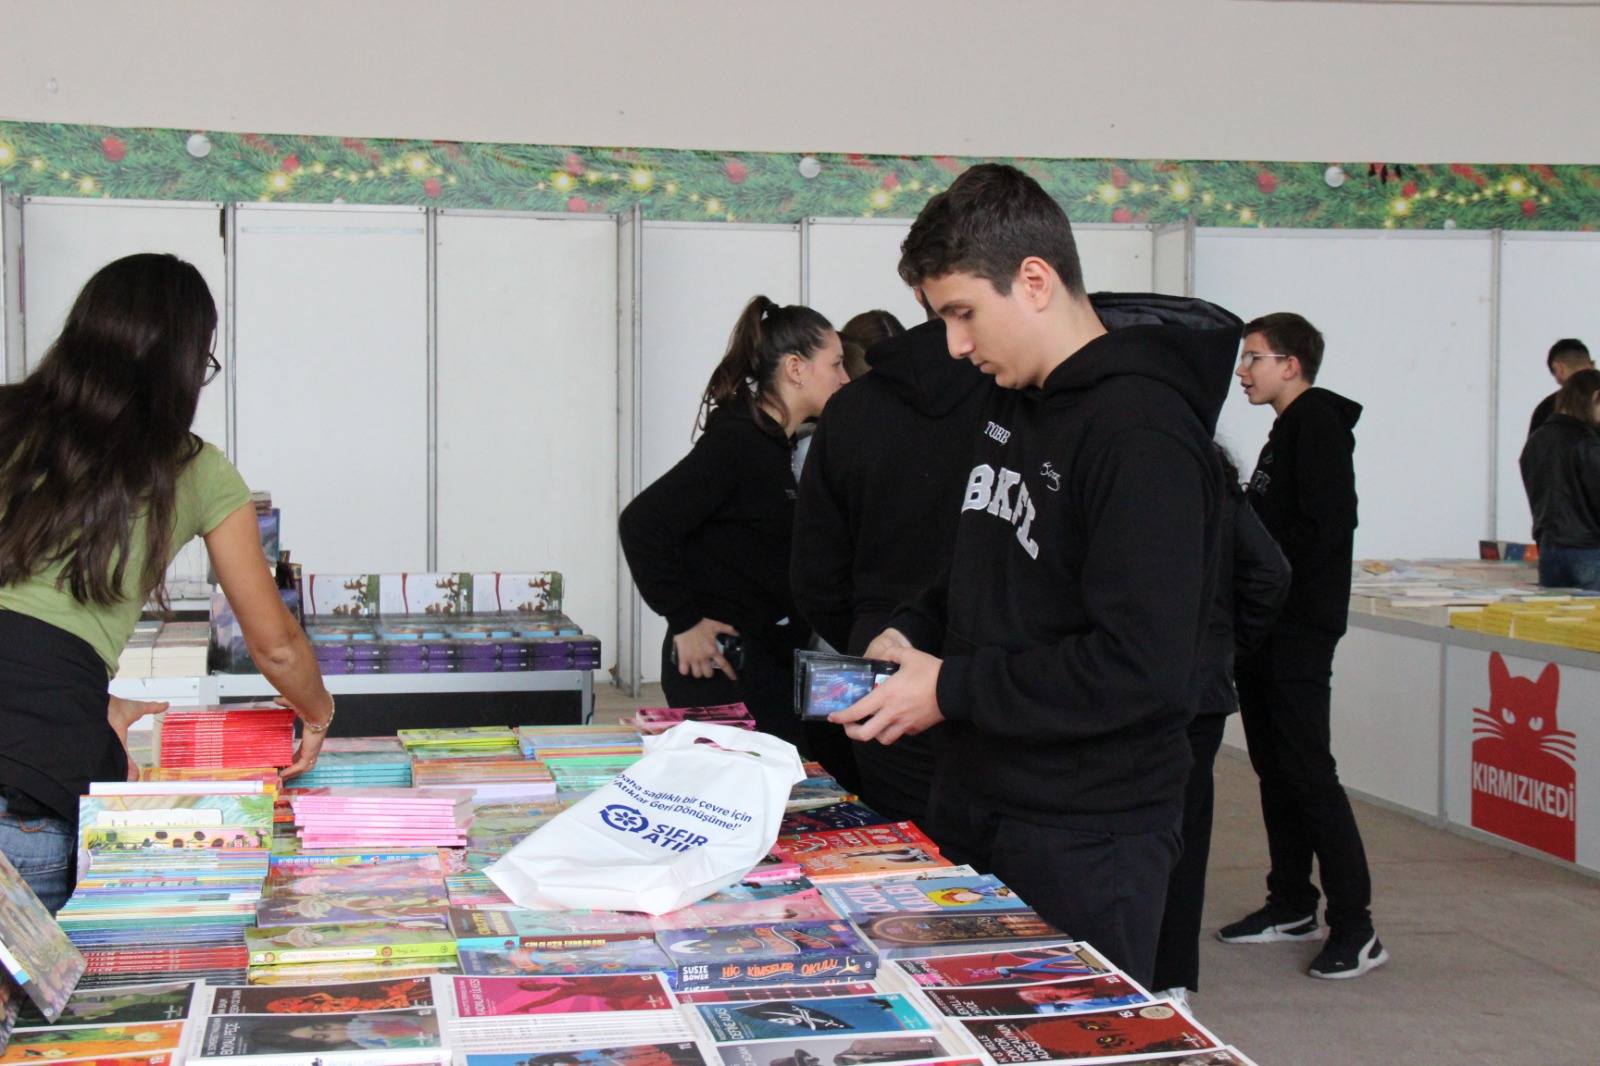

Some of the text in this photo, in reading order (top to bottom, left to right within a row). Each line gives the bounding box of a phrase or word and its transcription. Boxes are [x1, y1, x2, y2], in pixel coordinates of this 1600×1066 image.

[984, 420, 1011, 444] TOBB
[1473, 761, 1574, 821] KIRMIZIKEDİ
[644, 789, 680, 803] sağlıklı
[682, 795, 698, 804] bir
[699, 800, 730, 816] çevre
[732, 809, 752, 823] için
[650, 800, 674, 812] Geri
[652, 824, 708, 846] SIFIR
